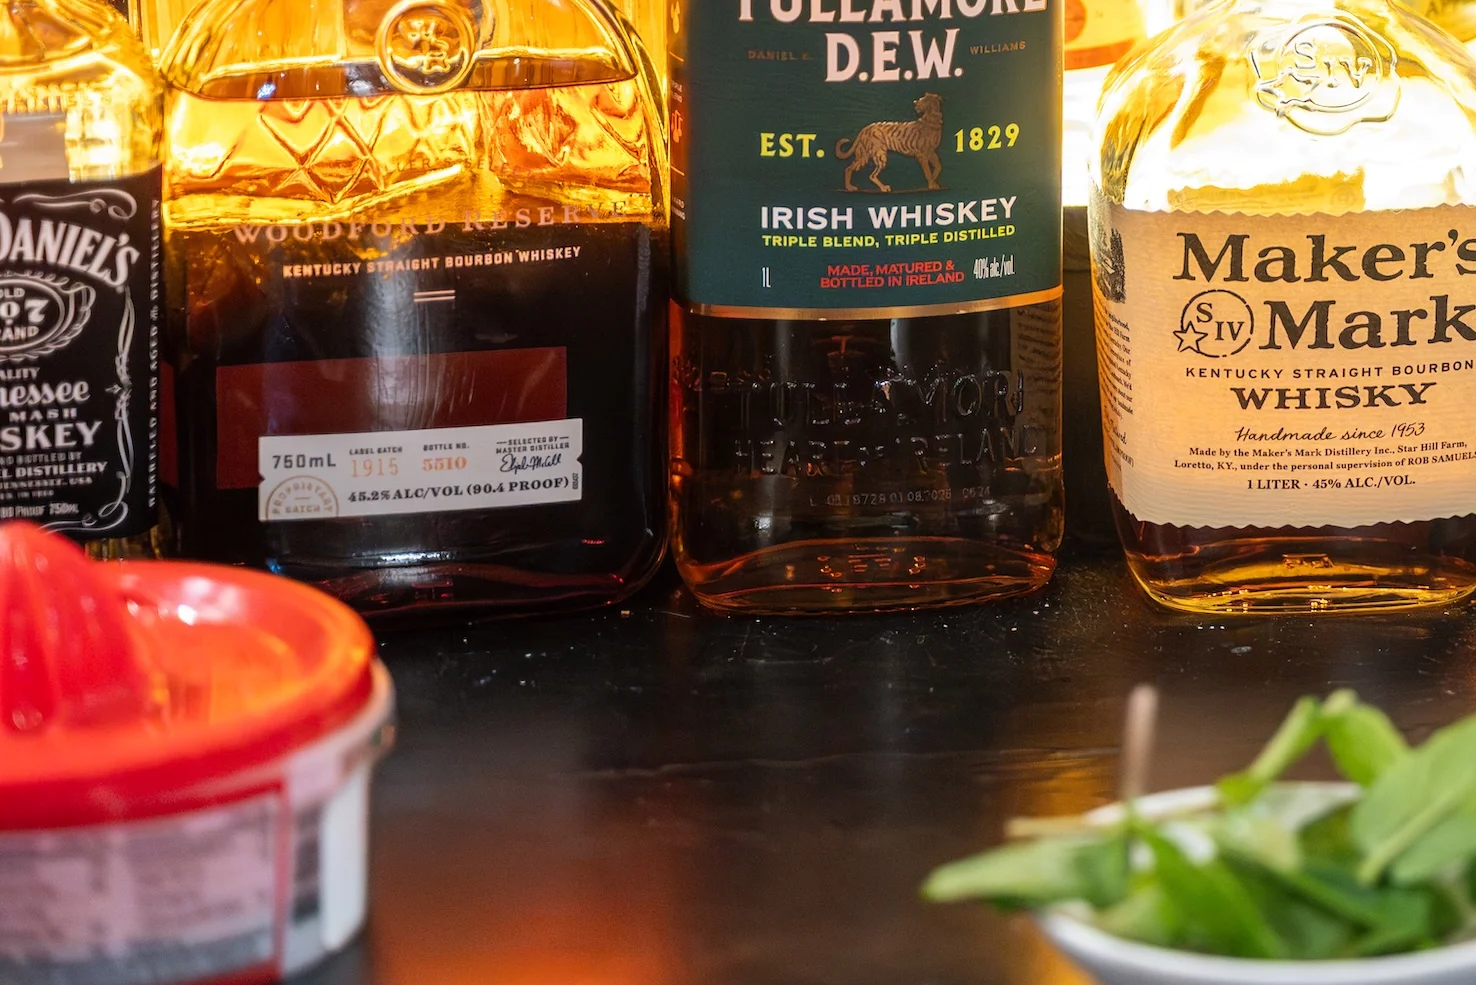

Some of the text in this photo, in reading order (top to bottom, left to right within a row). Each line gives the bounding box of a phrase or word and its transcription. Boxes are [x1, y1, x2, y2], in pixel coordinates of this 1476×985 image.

[747, 49, 798, 61] DANIEL
[825, 28, 964, 83] D.E.W.
[969, 40, 1026, 56] WILLIAMS
[760, 131, 825, 158] EST.
[954, 122, 1020, 153] 1829
[232, 199, 628, 245] WOODFORD RESERVE
[761, 196, 1017, 230] IRISH WHISKEY
[762, 225, 1016, 248] TRIPLE BLEND, TRIPLE DISTILLED
[283, 246, 582, 279] KENTUCKY STRAIGHT BOURBON WHISKEY
[828, 260, 955, 276] MADE, MATURED &
[973, 257, 989, 279] 40%
[762, 266, 771, 288] 1L
[820, 272, 964, 288] BOTTLED IN IRELAND
[1185, 359, 1474, 379] KENTUCKY STRAIGHT BOURBON
[1230, 382, 1436, 410] WHISKY
[9, 407, 77, 423] MASH
[0, 421, 103, 451] SKEY
[508, 437, 546, 445] SELECTED
[1235, 422, 1426, 442] Handmade since 1953
[423, 443, 452, 451] BOTTLE
[496, 442, 569, 454] MASTER DISTILLER
[1189, 447, 1217, 457] Made
[1219, 447, 1230, 458] by
[1233, 447, 1250, 456] the
[1252, 447, 1292, 457] Maker's
[1295, 447, 1322, 457] Mark
[1325, 446, 1371, 457] Distillery
[1397, 444, 1417, 453] Star
[1421, 442, 1438, 452] Hill
[1440, 440, 1468, 451] Farm,
[16, 452, 67, 466] BOTTLED
[272, 453, 336, 469] 750mL
[352, 457, 398, 478] 1915
[422, 456, 467, 471] 5510
[1174, 460, 1214, 471] Loretto,
[1217, 461, 1238, 472] KY.,
[1240, 462, 1267, 471] under
[1269, 462, 1288, 471] the
[1291, 461, 1333, 472] personal
[1336, 459, 1392, 471] supervision
[1395, 457, 1405, 466] of
[1407, 456, 1429, 466] ROB
[15, 461, 108, 478] DISTILLERY
[349, 490, 390, 502] 45.2%
[393, 485, 463, 499] ALC/VOL
[467, 483, 508, 495] (90.4
[509, 477, 569, 492] PROOF)
[1248, 474, 1416, 489] 1 LITER 45% ALC./VOL.
